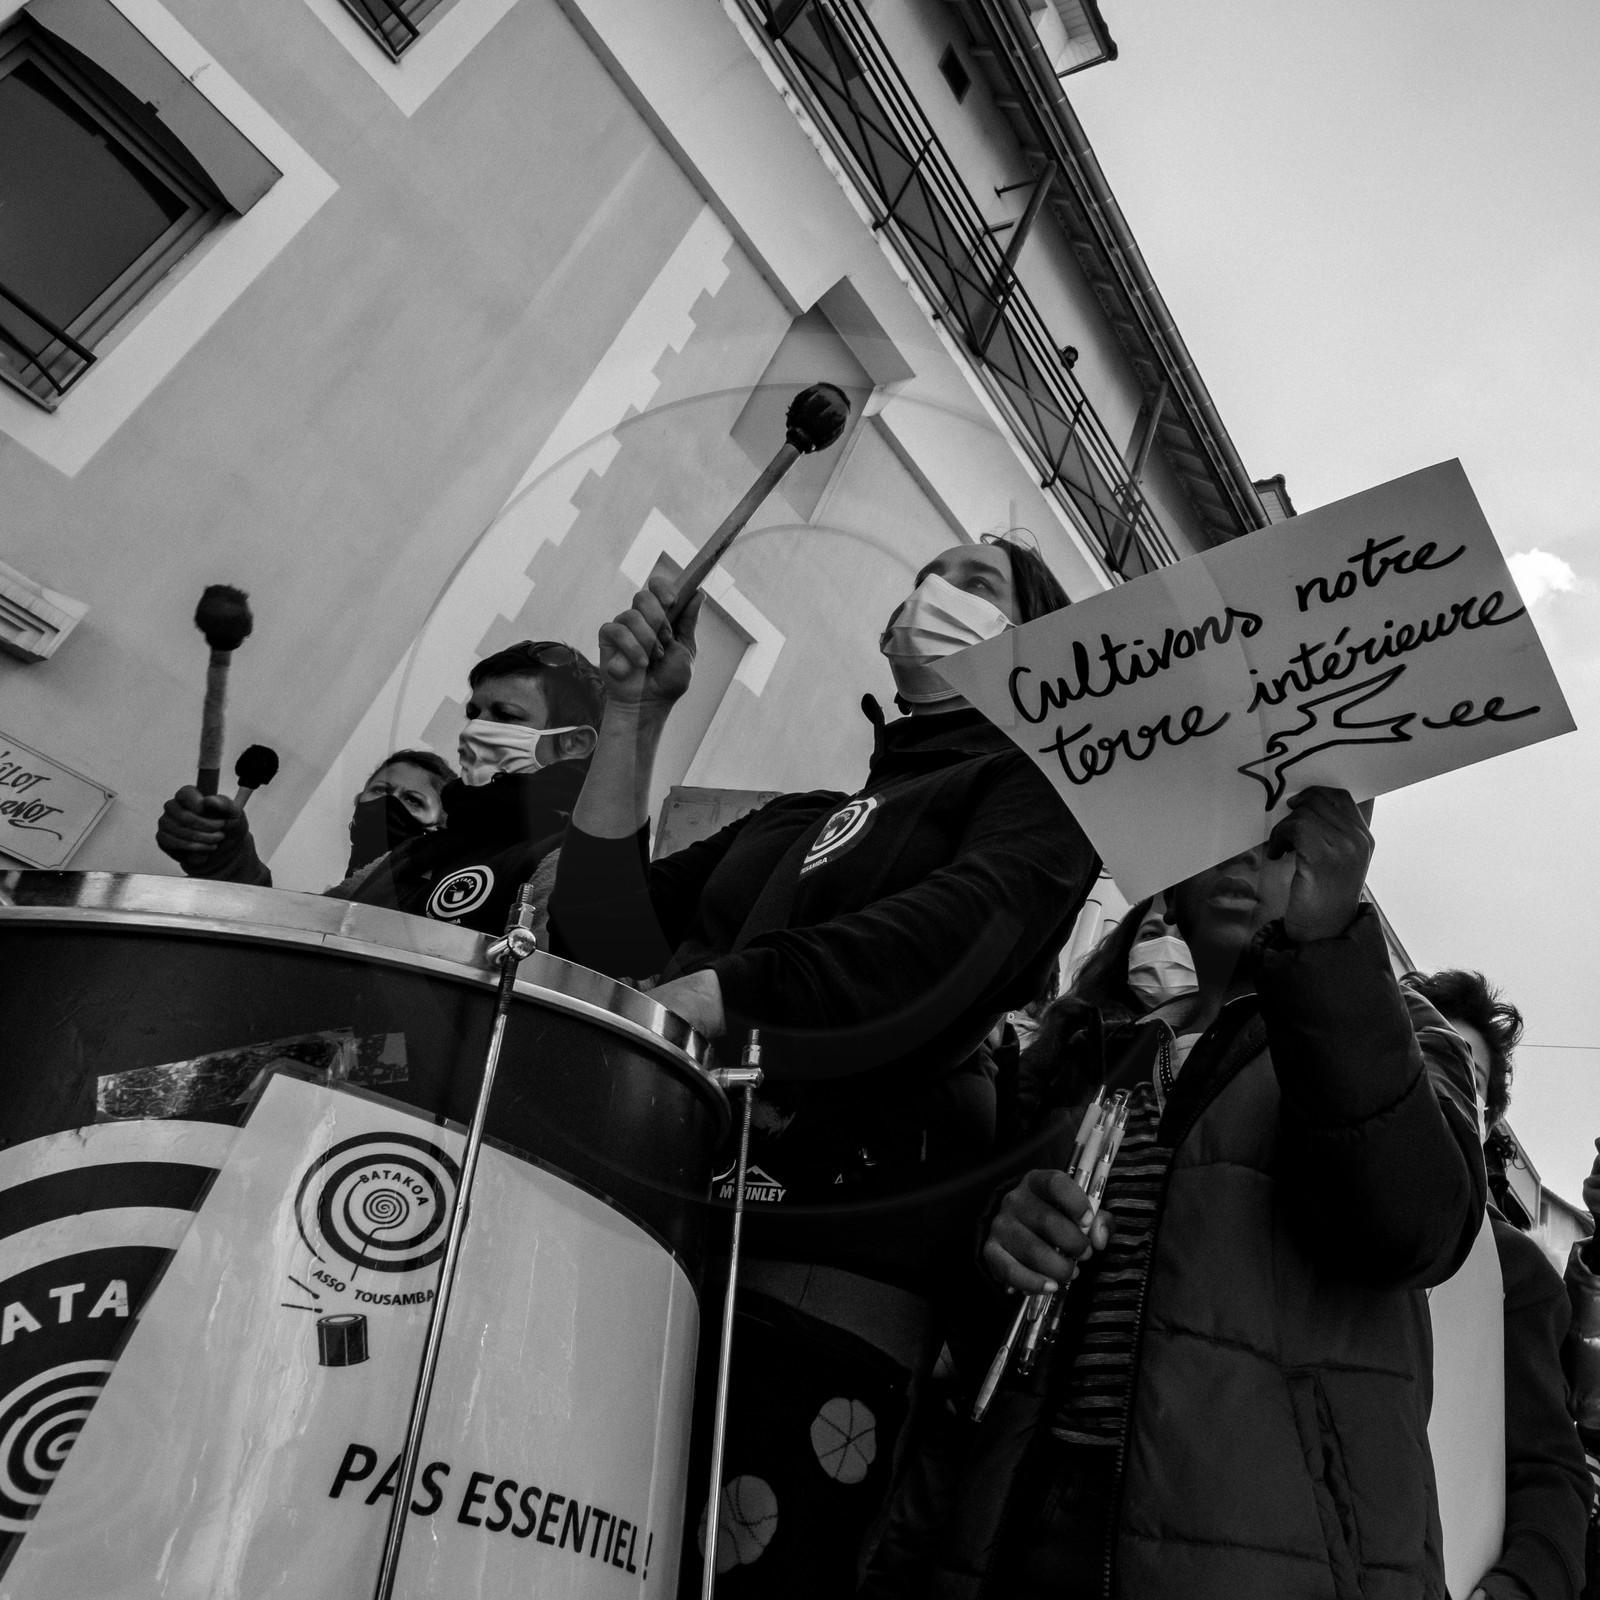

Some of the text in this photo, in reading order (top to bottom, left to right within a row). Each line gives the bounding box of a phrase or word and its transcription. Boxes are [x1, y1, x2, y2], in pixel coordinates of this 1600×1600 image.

[1008, 535, 1467, 723] Cultivons notre
[1039, 591, 1527, 785] terre intérieure
[0, 798, 64, 823] RNOT
[359, 1170, 430, 1206] BATAKOA
[719, 1184, 787, 1202] MINLEY
[312, 1269, 435, 1306] ASSO TOUSAMBA
[328, 1443, 451, 1517] PAS
[457, 1471, 638, 1575] ESSENTIEL
